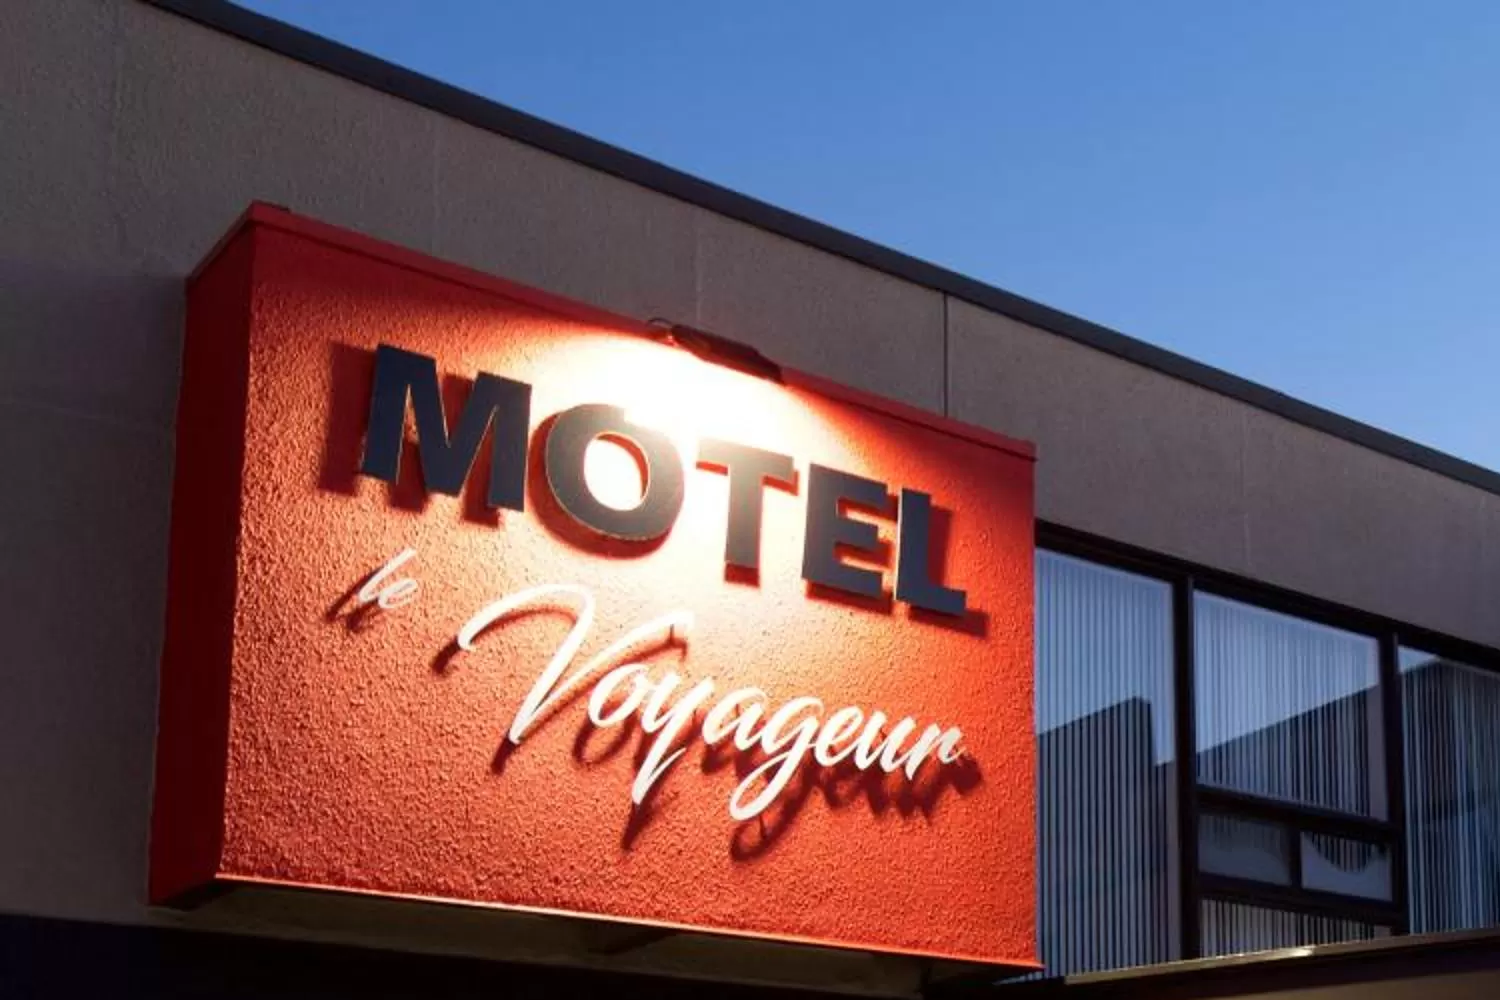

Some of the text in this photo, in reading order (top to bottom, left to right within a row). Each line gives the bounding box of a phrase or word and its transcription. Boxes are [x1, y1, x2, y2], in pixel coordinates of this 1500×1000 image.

[361, 344, 967, 614] MOTEL
[358, 549, 966, 820] le Voyageur
